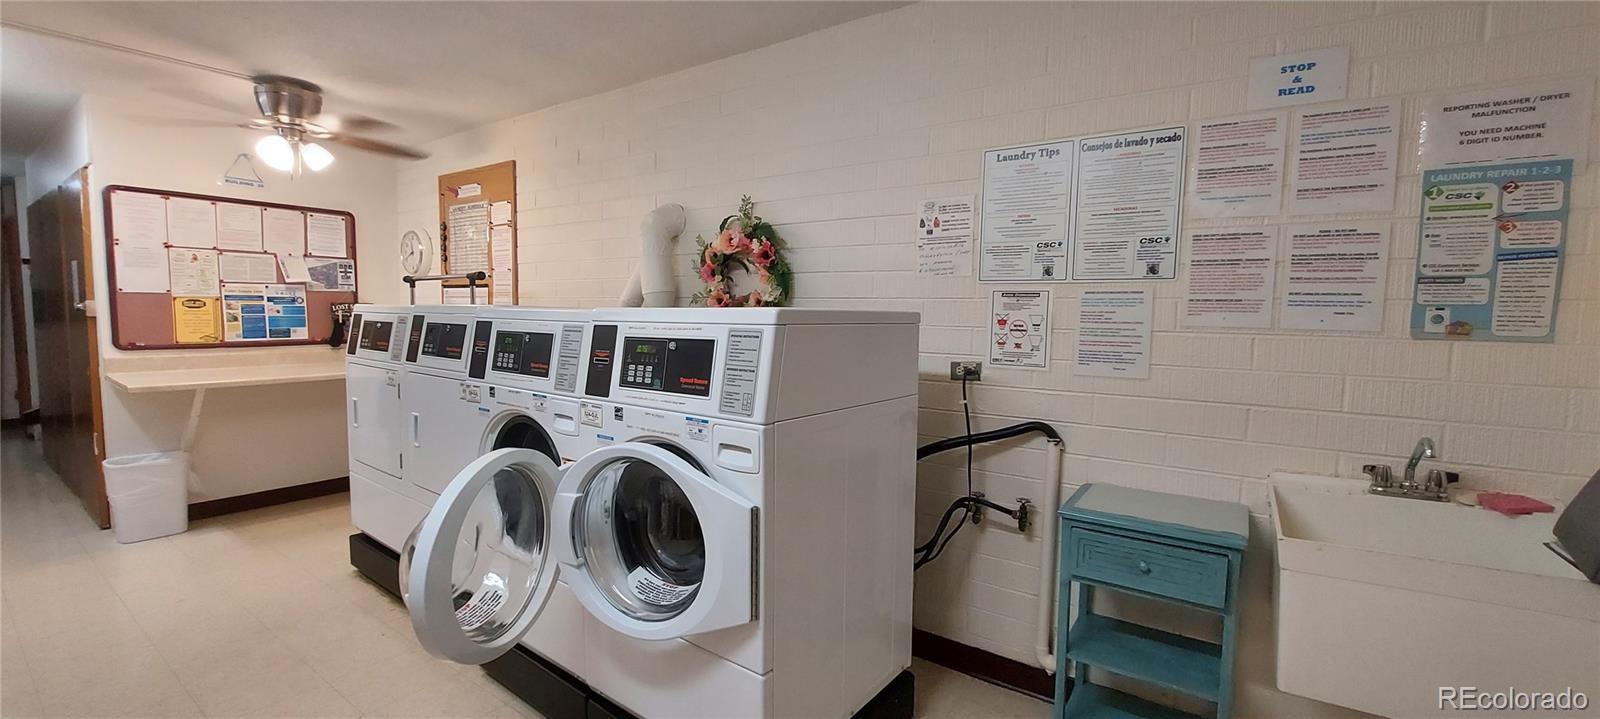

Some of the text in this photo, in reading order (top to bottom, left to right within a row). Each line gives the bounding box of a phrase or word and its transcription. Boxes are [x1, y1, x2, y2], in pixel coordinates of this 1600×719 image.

[1280, 62, 1316, 74] STOP
[1292, 75, 1303, 84] &
[1278, 85, 1315, 97] READ
[1443, 92, 1571, 113] REPORTING WASHER / DRYER
[1471, 105, 1537, 119] MALFUNCTION
[1459, 122, 1548, 138] YOU NEED MACHINE
[1081, 132, 1183, 153] Consejos de lavado y secado
[1466, 136, 1489, 145] DIGIT
[1502, 131, 1545, 142] NUMBER.
[996, 147, 1061, 163] Laundry Tips
[1430, 165, 1562, 183] LAUNDRY REPAIR 1-2-3
[1430, 186, 1438, 199] 1
[1505, 182, 1517, 193] 2
[1445, 192, 1473, 200] CSC
[1503, 222, 1514, 234] 3
[1036, 241, 1057, 249] CSC
[1139, 236, 1164, 245] CSC
